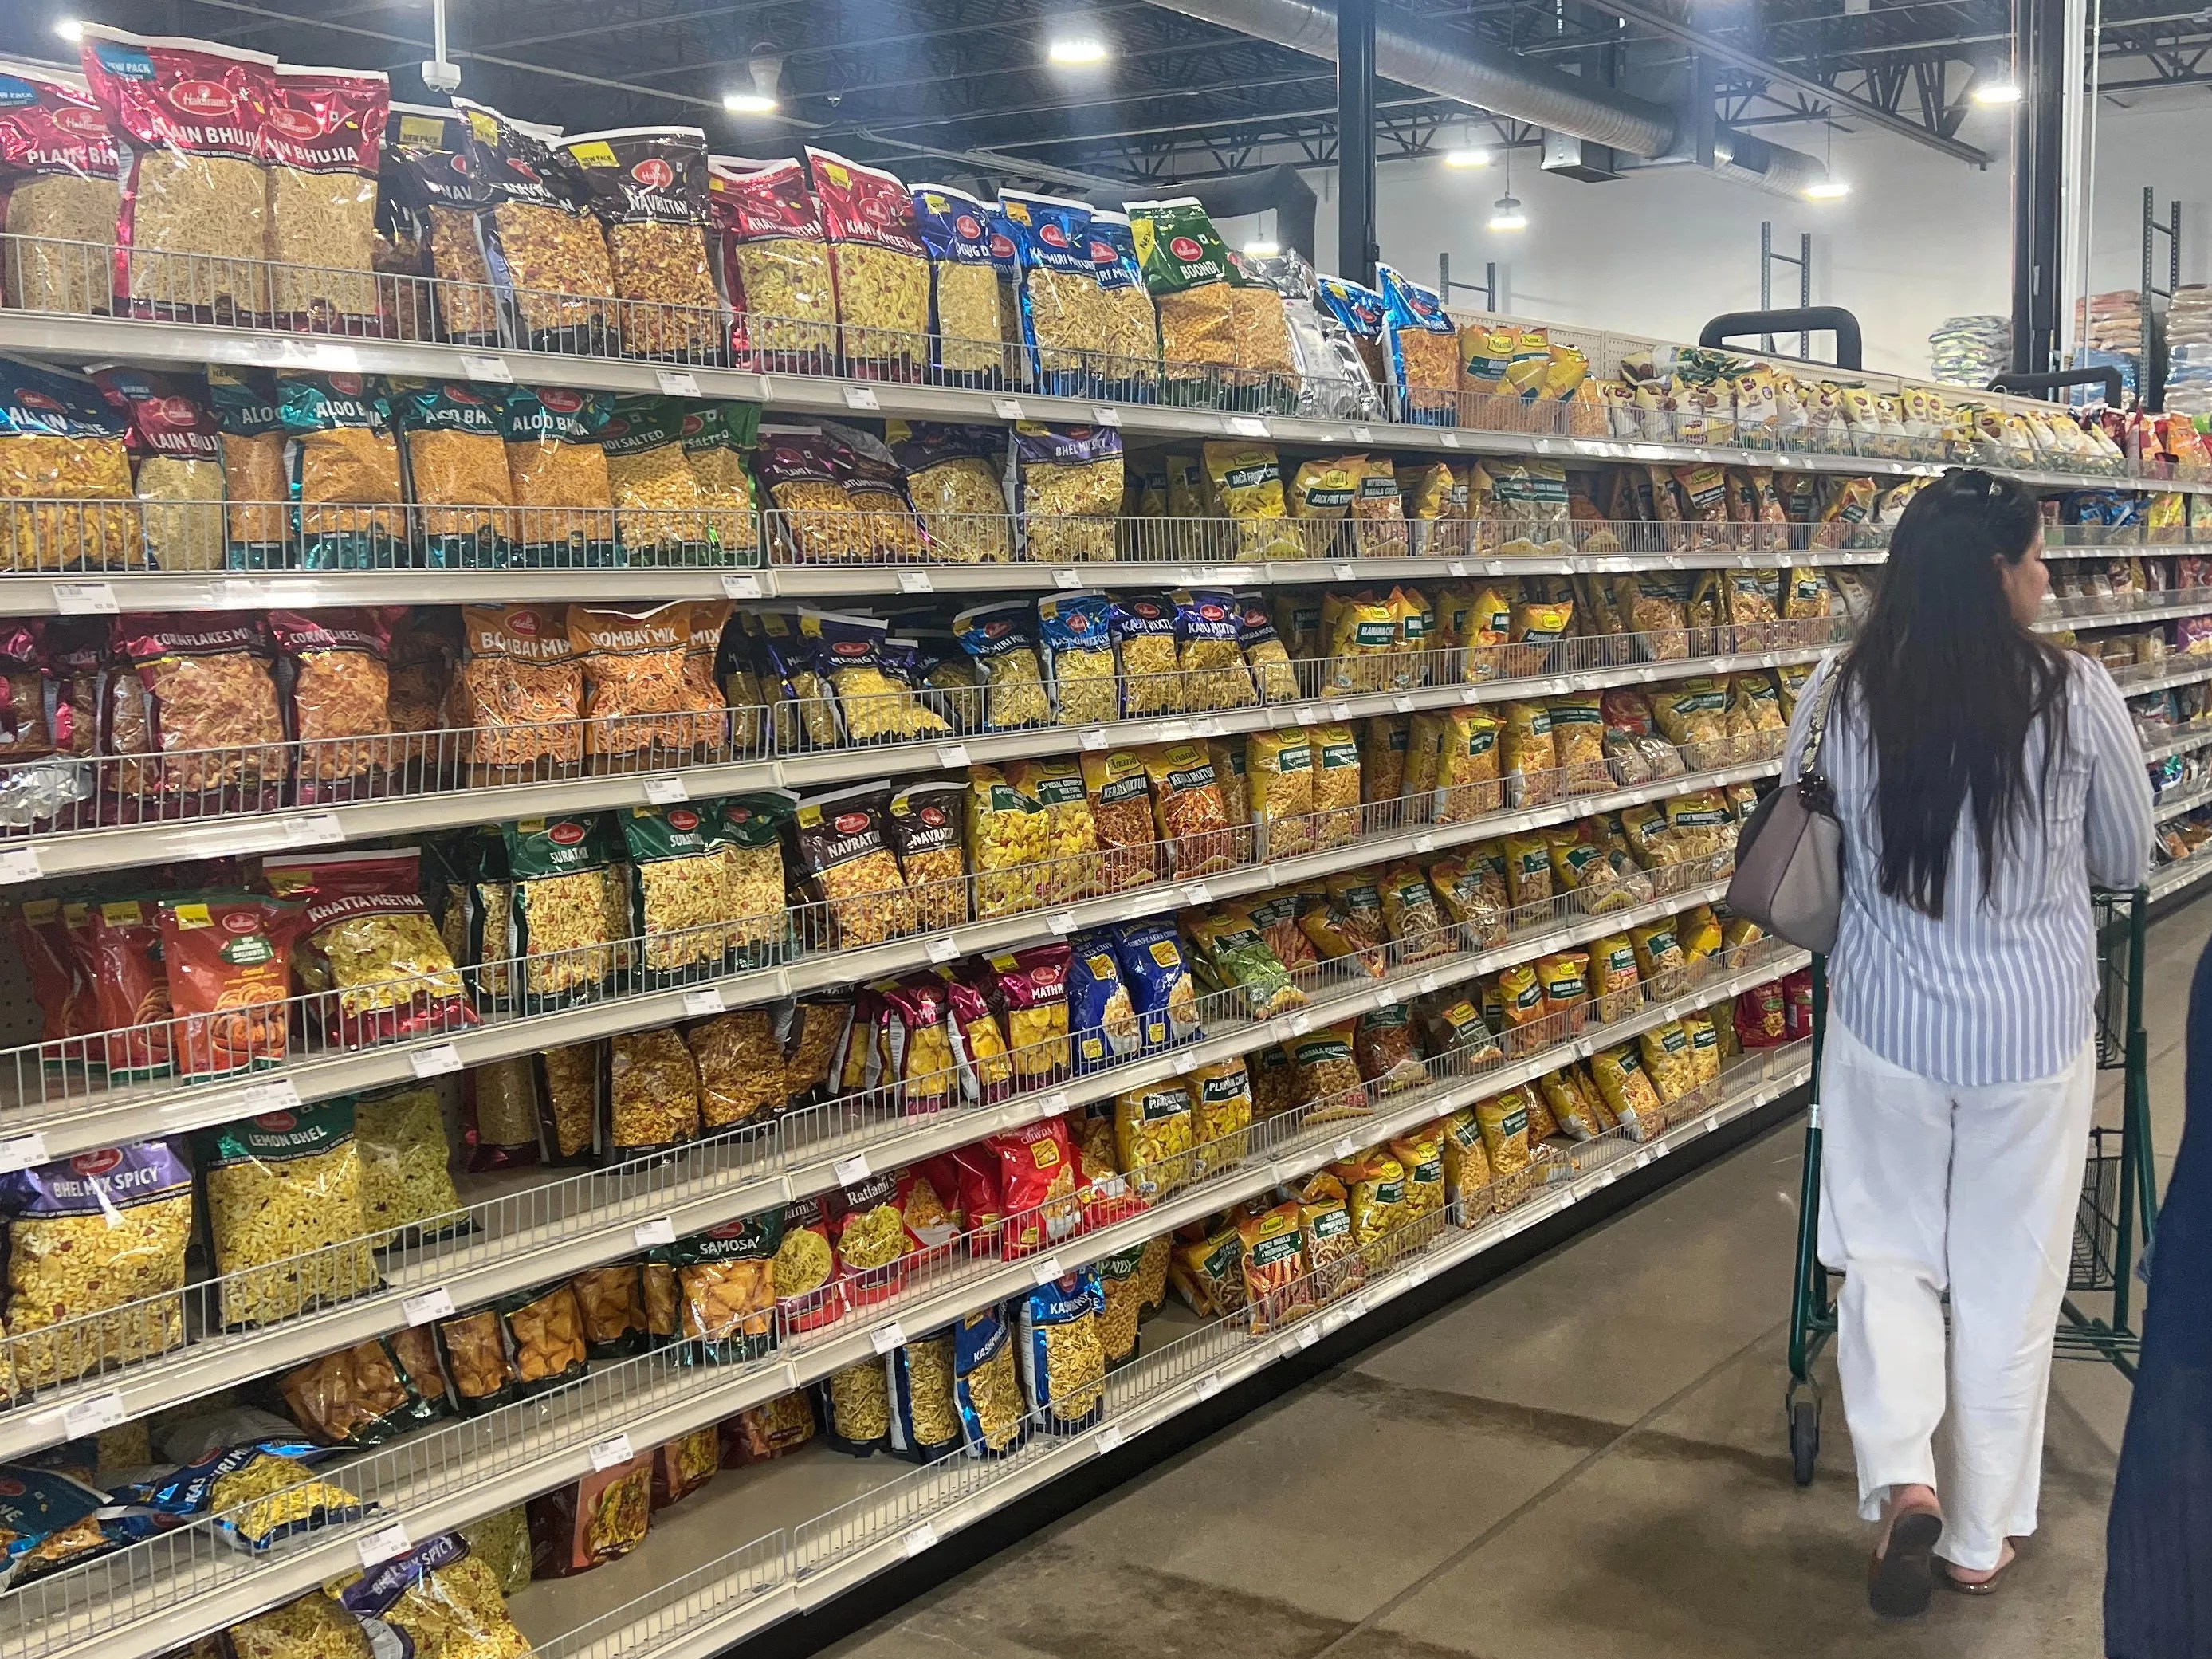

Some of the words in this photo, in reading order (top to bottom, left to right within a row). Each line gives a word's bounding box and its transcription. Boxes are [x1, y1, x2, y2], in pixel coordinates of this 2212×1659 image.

[132, 63, 151, 74] PACK
[304, 143, 358, 163] BHUJIA
[1180, 261, 1219, 280] BOONDI
[316, 399, 357, 419] ALOO
[623, 430, 665, 447] SALTED
[1056, 442, 1078, 458] BHEL
[153, 631, 233, 647] CORNFLAKES
[591, 630, 650, 648] BOMBAY
[690, 628, 721, 647] MIX
[308, 896, 371, 922] KHATTA
[371, 894, 424, 909] MEETHA
[249, 1133, 291, 1148] LEMON
[291, 1125, 328, 1146] BHEL
[53, 1181, 84, 1198] BHEL
[114, 1166, 159, 1191] SPICY
[847, 1176, 889, 1206] Ratlami
[698, 1239, 754, 1255] SAMOSA
[422, 1537, 454, 1566] SPICY
